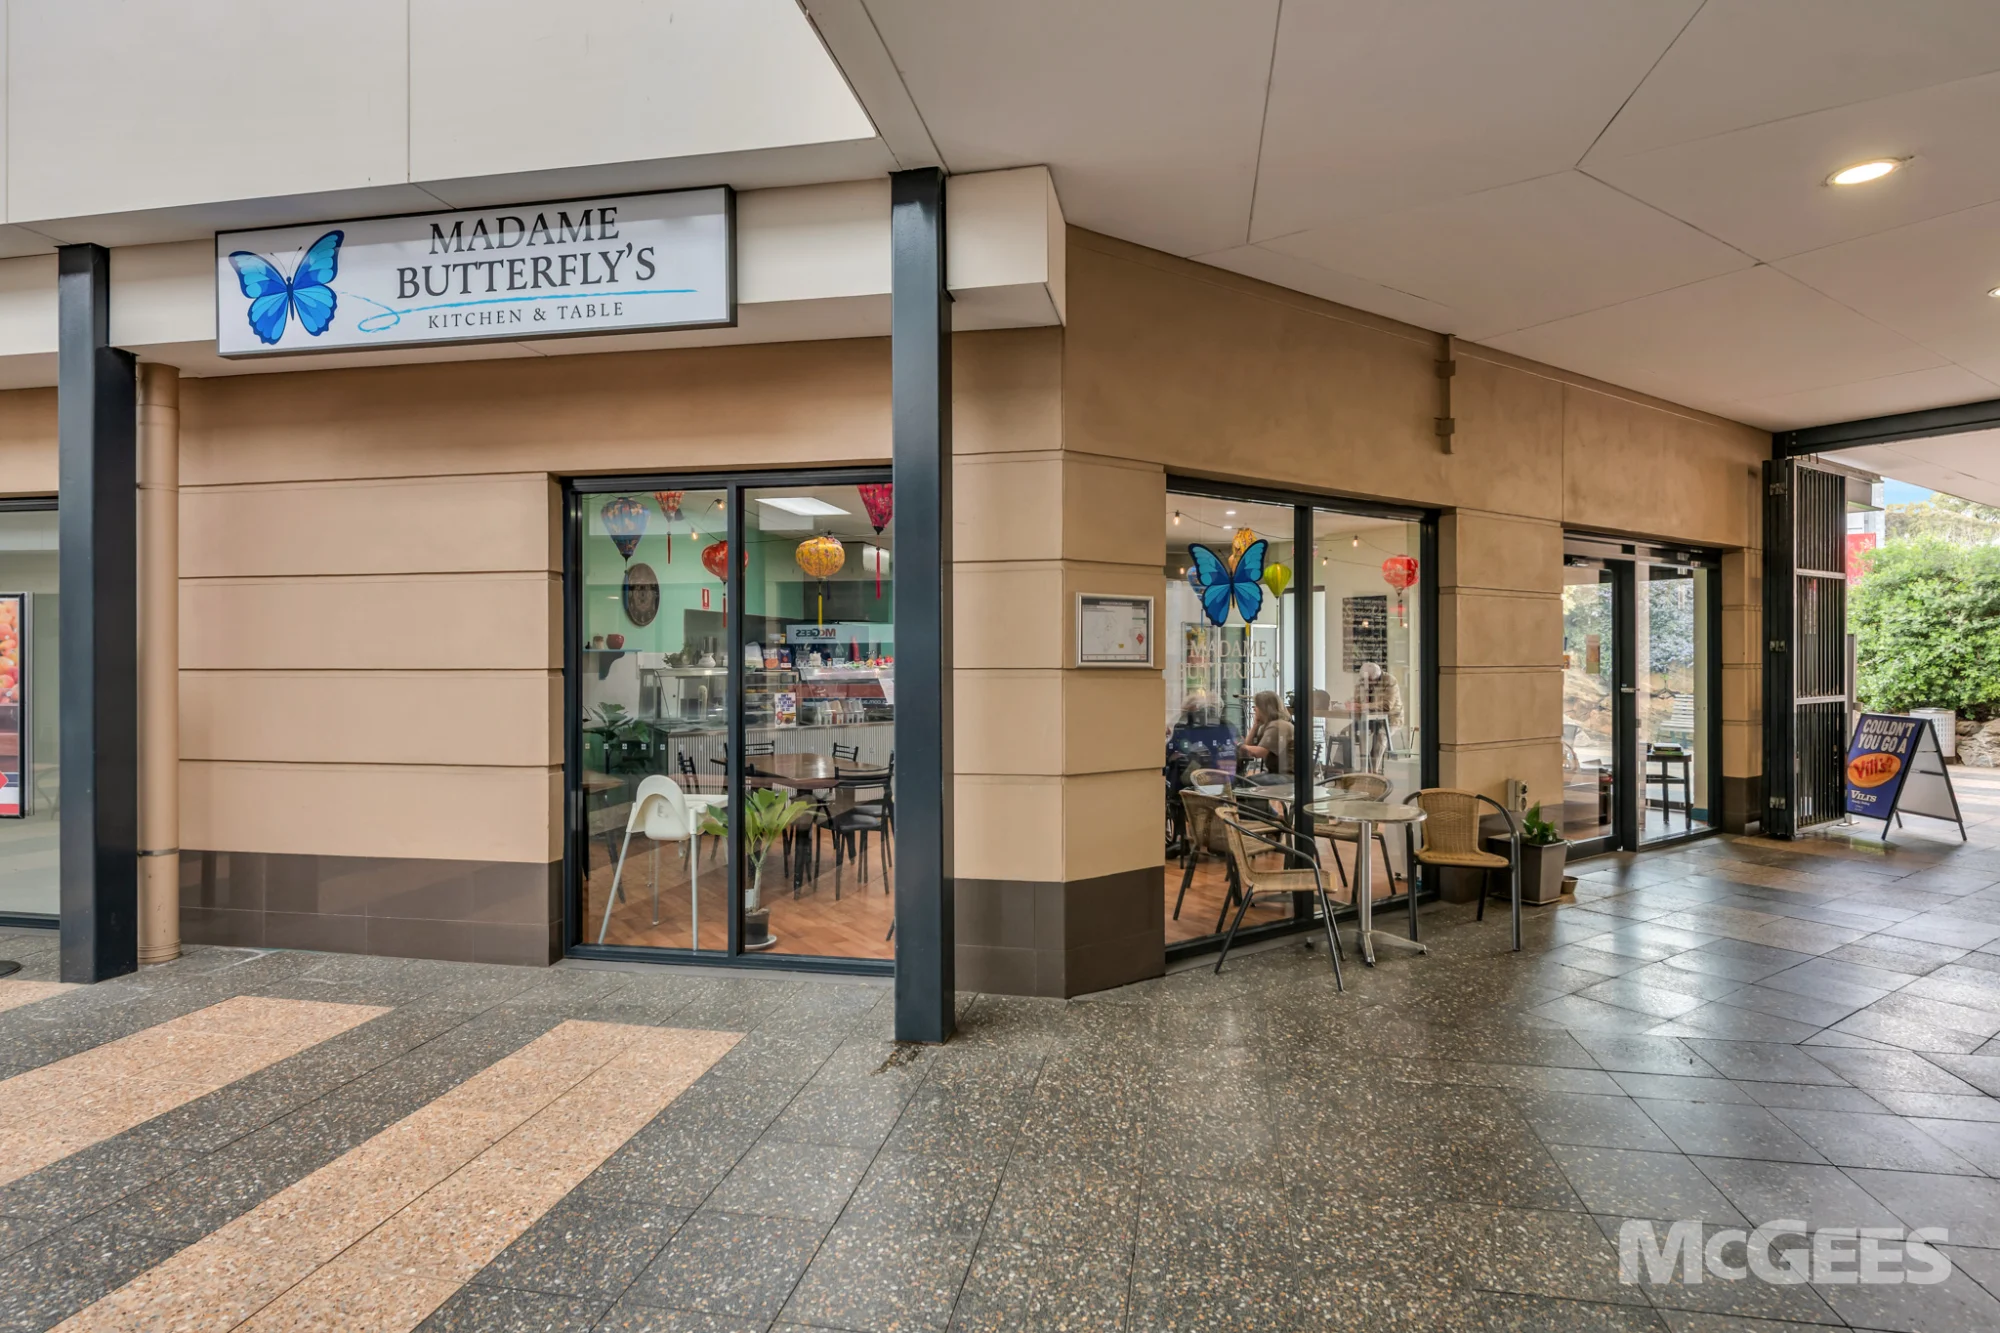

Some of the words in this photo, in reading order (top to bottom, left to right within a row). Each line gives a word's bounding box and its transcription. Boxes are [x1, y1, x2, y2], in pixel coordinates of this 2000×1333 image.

[428, 206, 619, 254] MADAME
[396, 242, 656, 299] BUTTERFLY'S
[428, 309, 523, 329] KITCHEN
[533, 307, 547, 321] &
[558, 302, 624, 319] TABLE
[1189, 640, 1267, 657] MADAME
[1178, 659, 1280, 679] BUTTERFLY'S
[1863, 719, 1915, 737] COULDN'T
[1858, 733, 1881, 750] YOU
[1881, 736, 1898, 752] GO
[1897, 738, 1908, 754] A
